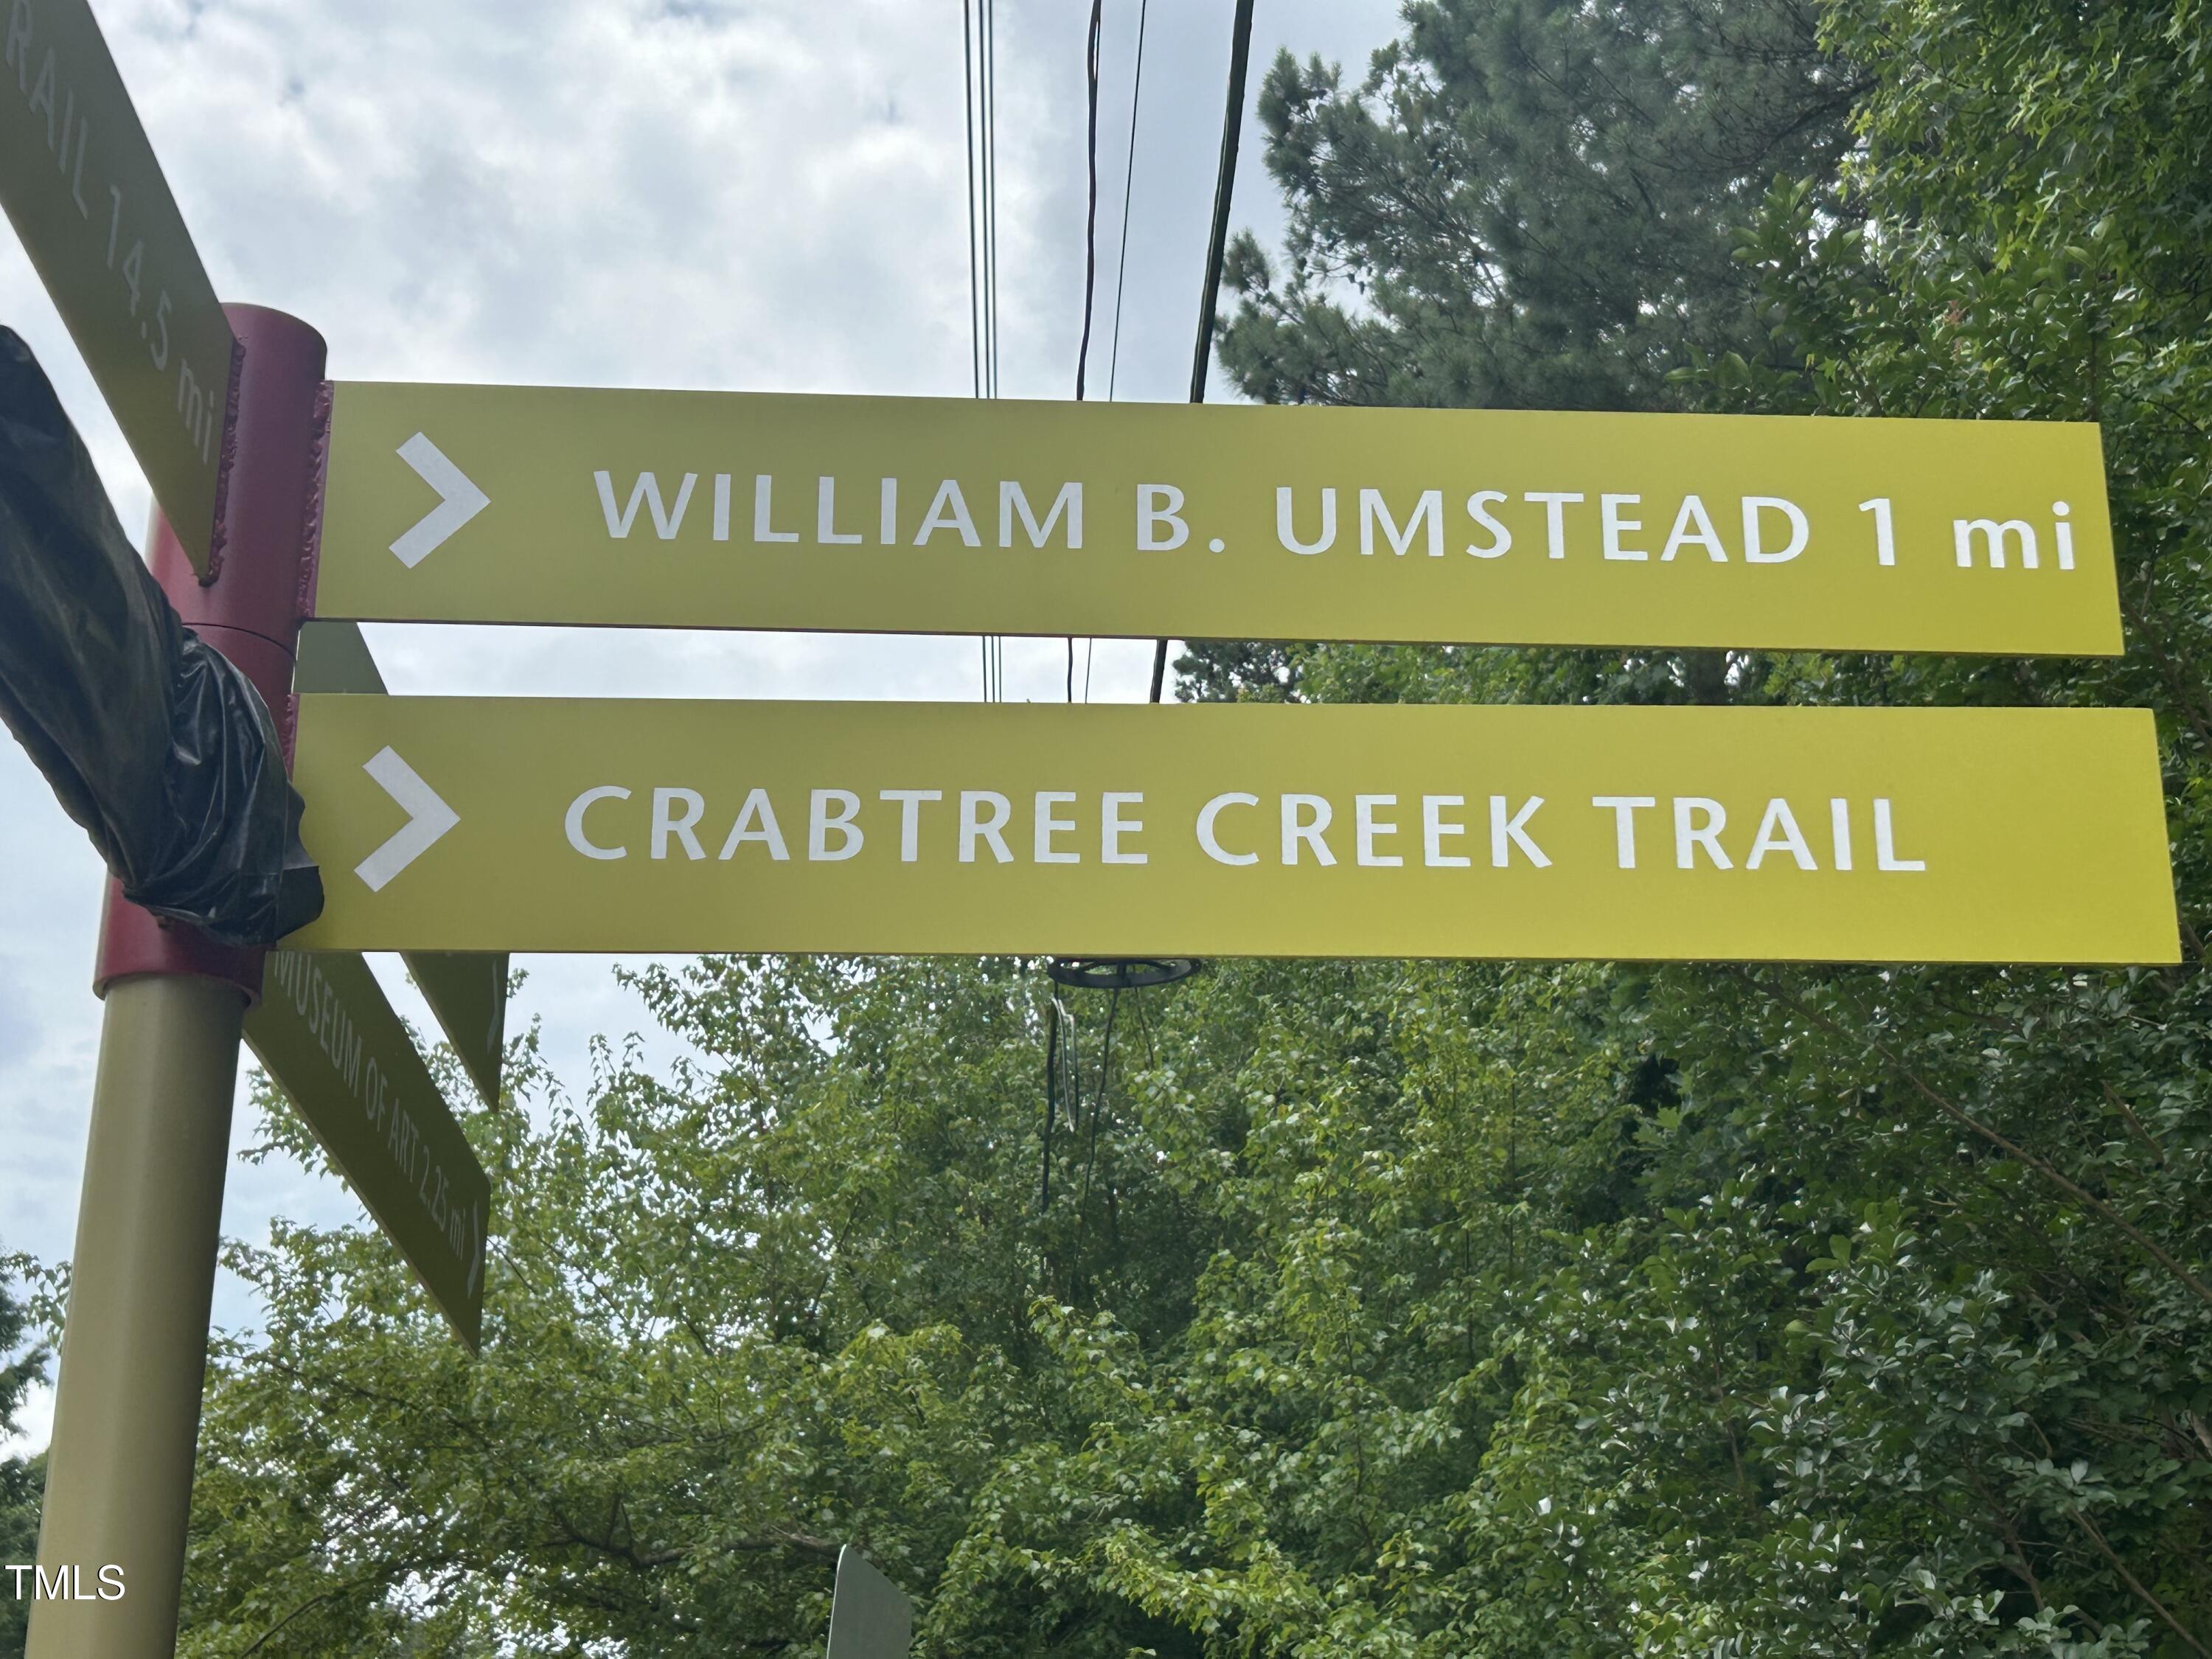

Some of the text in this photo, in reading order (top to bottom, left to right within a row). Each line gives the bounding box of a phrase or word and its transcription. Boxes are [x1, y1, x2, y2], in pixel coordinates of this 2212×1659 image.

[106, 183, 172, 371] 14.5
[177, 358, 215, 465] mi
[593, 470, 2076, 571] WILLIAM B. UMSTEAD 1 mi
[563, 785, 1927, 872] CRABTREE CREEK TRAIL
[274, 950, 466, 1262] MUSEUM OF ART 2.25 mi
